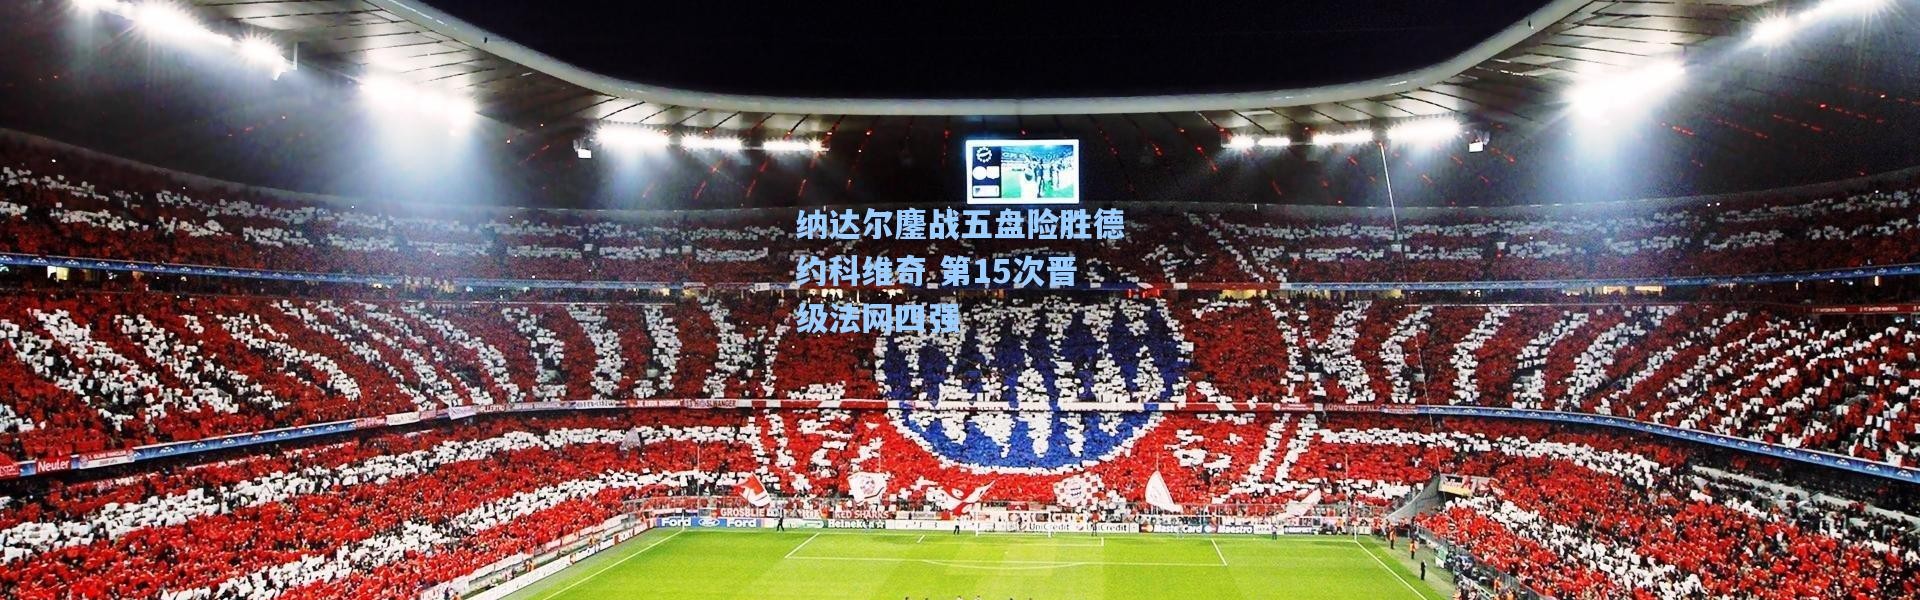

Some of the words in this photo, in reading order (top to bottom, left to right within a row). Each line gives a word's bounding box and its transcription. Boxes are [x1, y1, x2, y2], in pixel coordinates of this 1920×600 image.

[38, 459, 70, 472] Neuler
[661, 517, 692, 527] Ford
[726, 518, 757, 528] Ford
